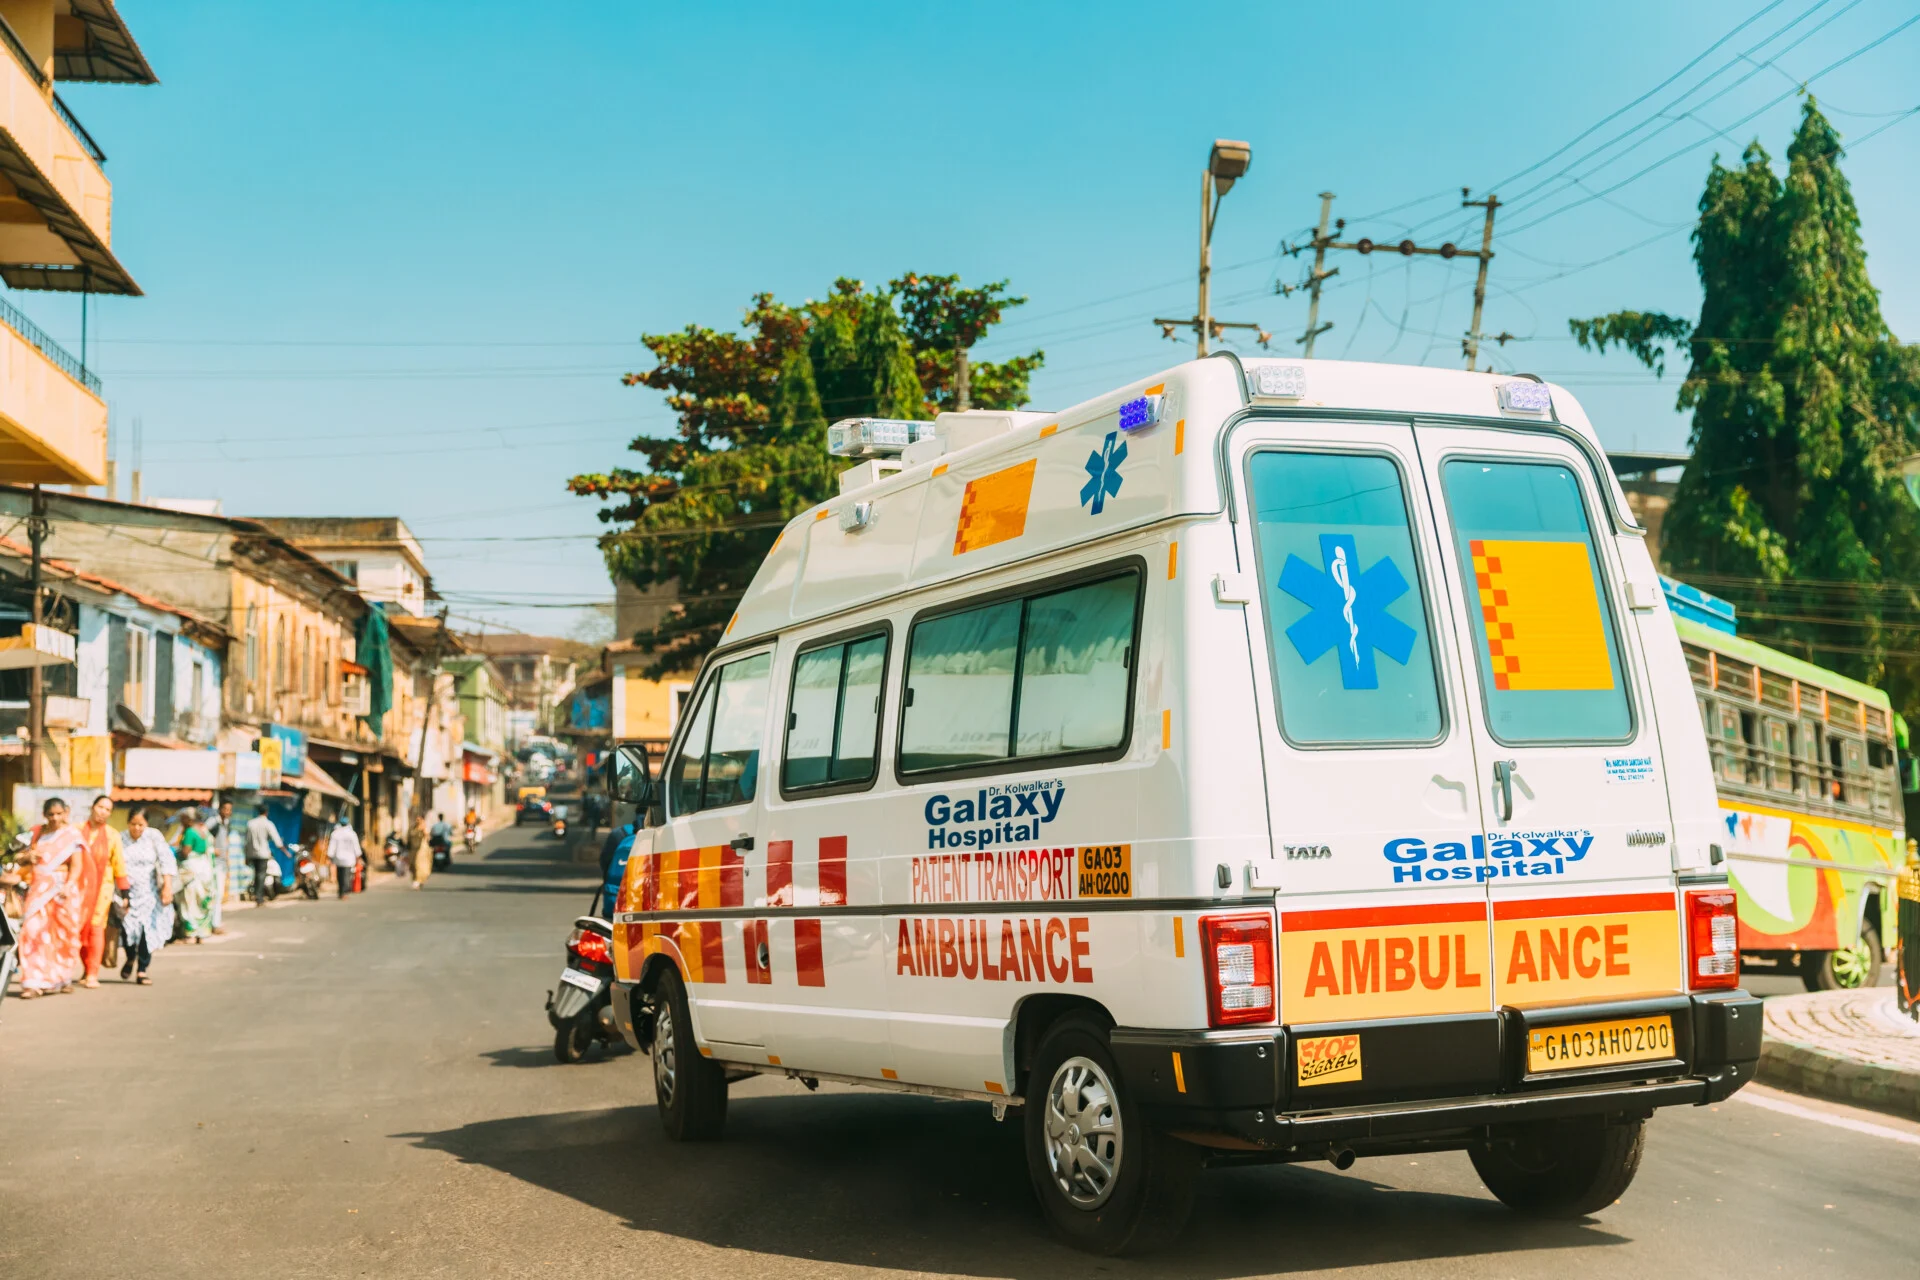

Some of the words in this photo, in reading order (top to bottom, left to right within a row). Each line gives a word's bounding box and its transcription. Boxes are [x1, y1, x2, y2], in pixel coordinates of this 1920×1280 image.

[989, 786, 1002, 797] Dr.
[1004, 779, 1063, 795] Kolwalkar's
[924, 787, 1066, 826] Galaxy
[928, 818, 1040, 850] Hospital
[1383, 834, 1595, 864] Galaxy
[1487, 832, 1507, 841] Dr.
[1511, 828, 1591, 840] Kolwalkar's
[1284, 845, 1333, 860] TATA
[912, 853, 971, 904] PATIENT
[974, 847, 1075, 901] TRANSPORT
[1393, 857, 1565, 883] Hospital
[897, 916, 1094, 984] AMBULANCE
[1304, 933, 1482, 998] AMBUL
[1506, 923, 1630, 984] ANCE
[1546, 1023, 1669, 1061] GA03AH0200
